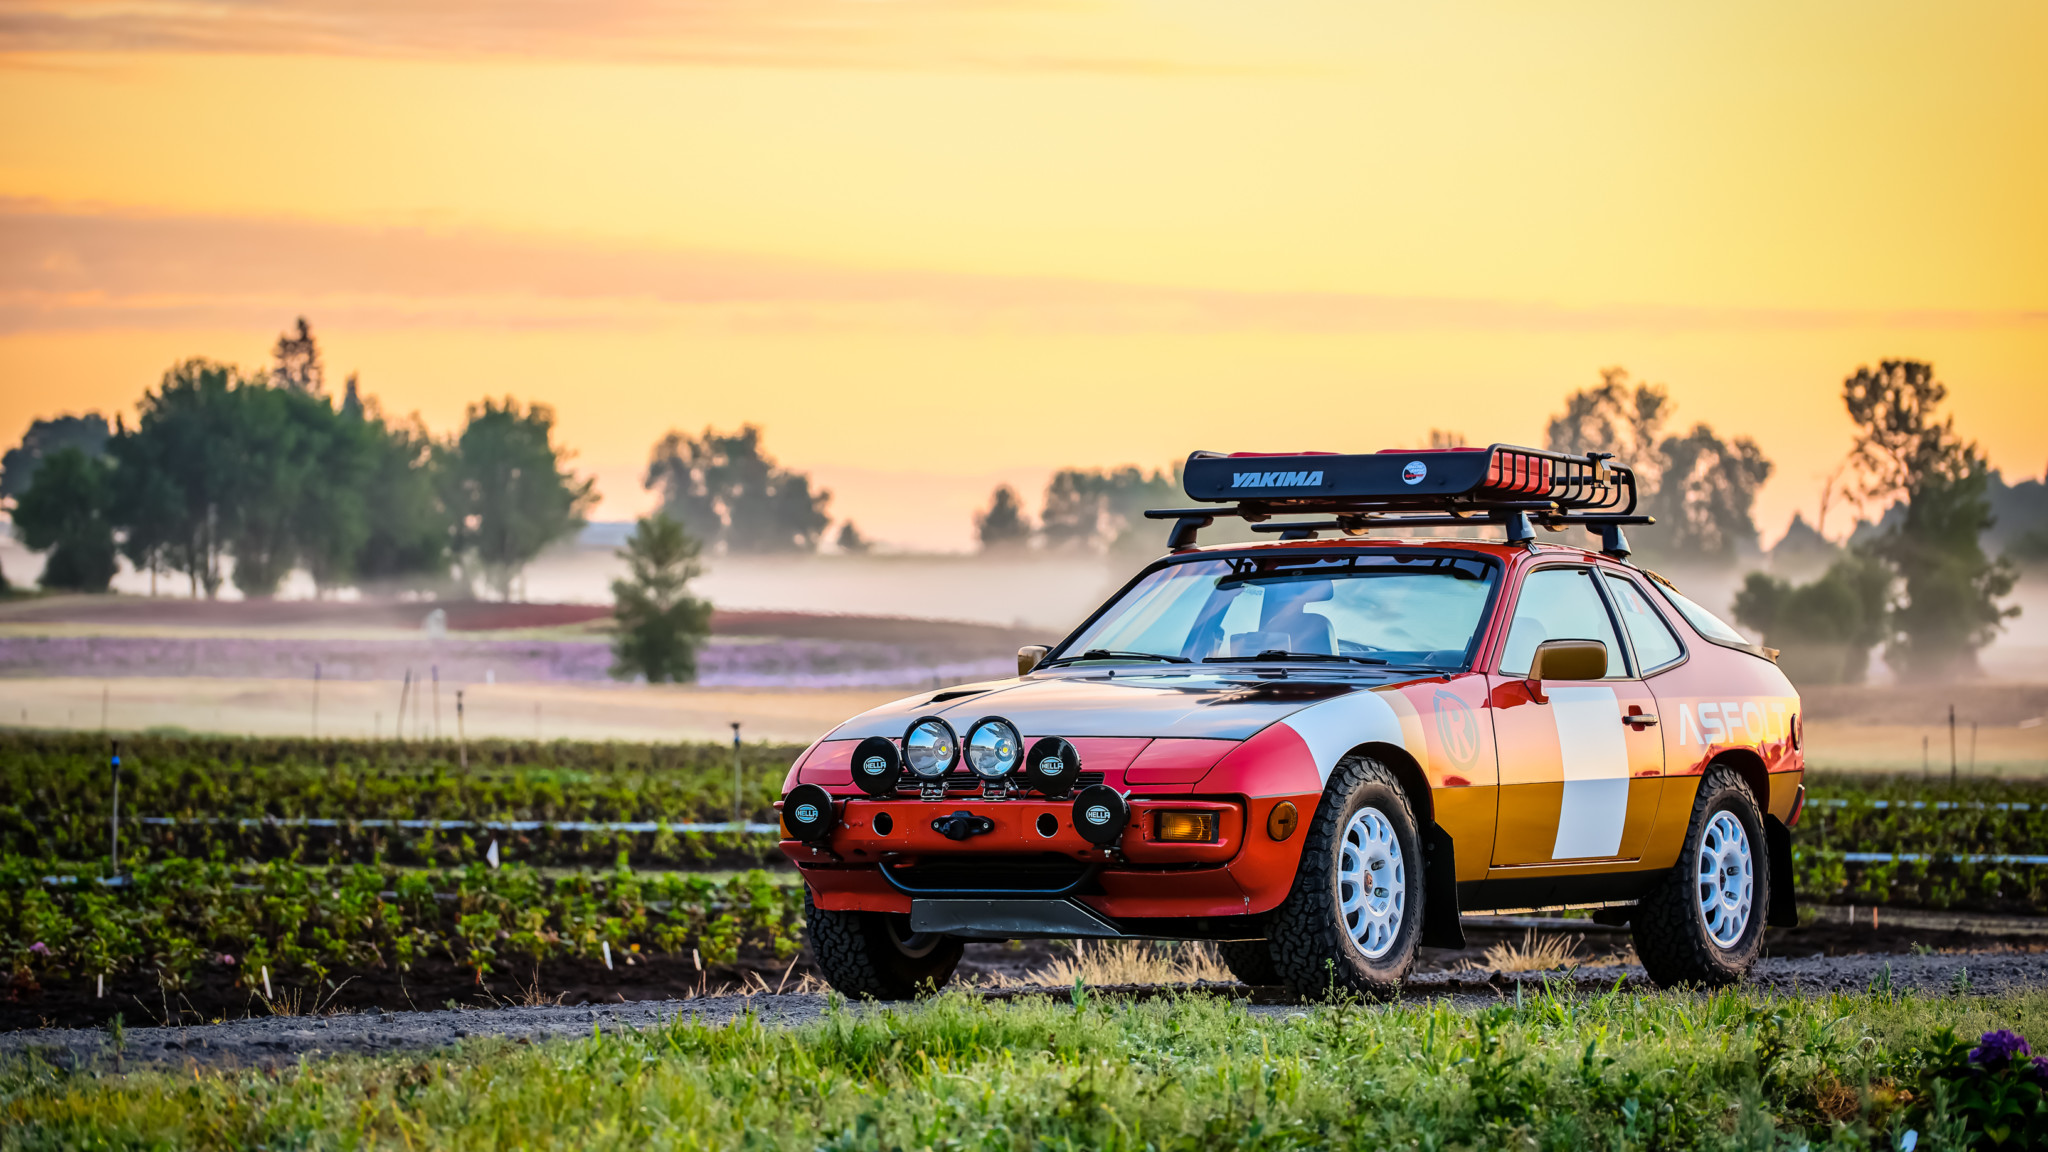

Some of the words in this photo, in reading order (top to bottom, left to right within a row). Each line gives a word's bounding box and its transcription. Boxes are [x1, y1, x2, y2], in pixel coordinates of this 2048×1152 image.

[1231, 471, 1324, 487] YAKIMA
[1679, 701, 1786, 745] ASFOLT
[865, 761, 887, 769] HELLA
[1041, 762, 1064, 770] HELLA
[1088, 811, 1111, 819] HELLA
